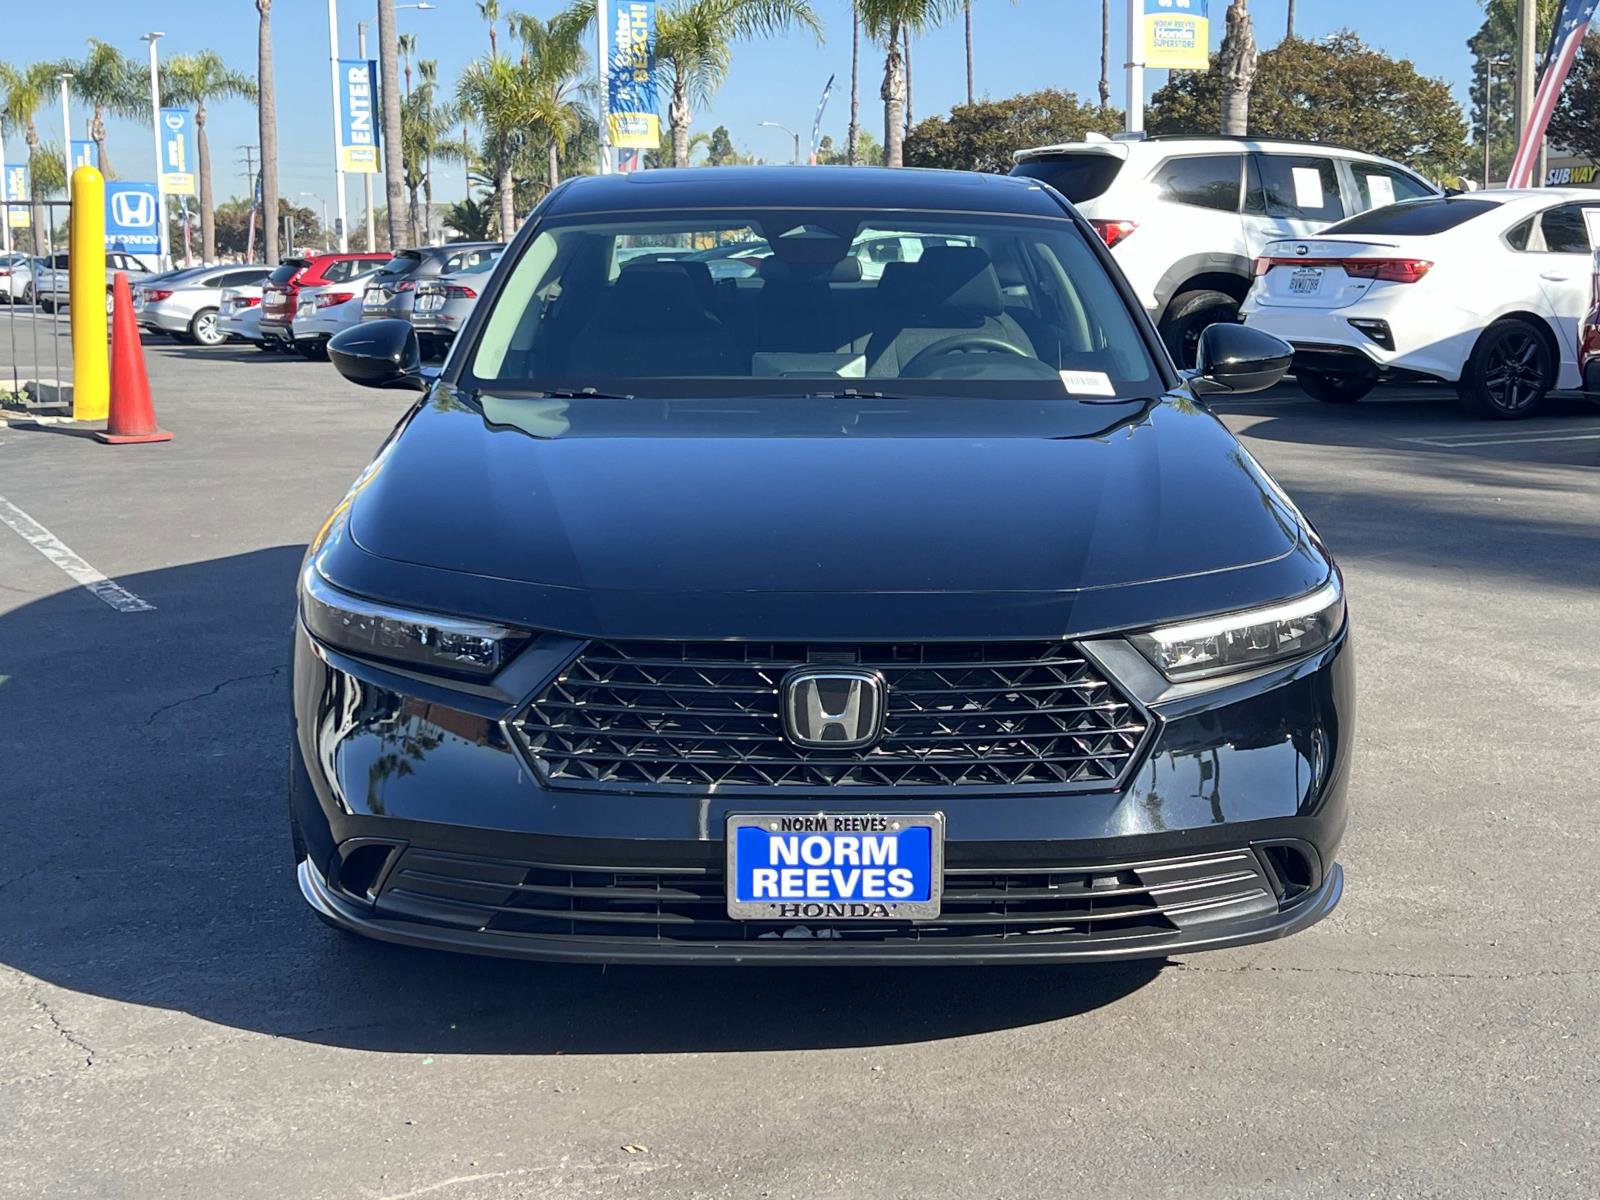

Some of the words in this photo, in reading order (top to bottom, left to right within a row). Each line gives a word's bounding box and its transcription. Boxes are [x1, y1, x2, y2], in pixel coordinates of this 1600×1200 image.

[347, 66, 370, 144] ENTER
[1546, 167, 1598, 185] SUBWAY
[781, 818, 828, 832] NORM
[834, 818, 887, 832] REEVES
[769, 836, 898, 866] NORM
[752, 868, 915, 898] REEVES
[778, 903, 891, 918] HONDA
